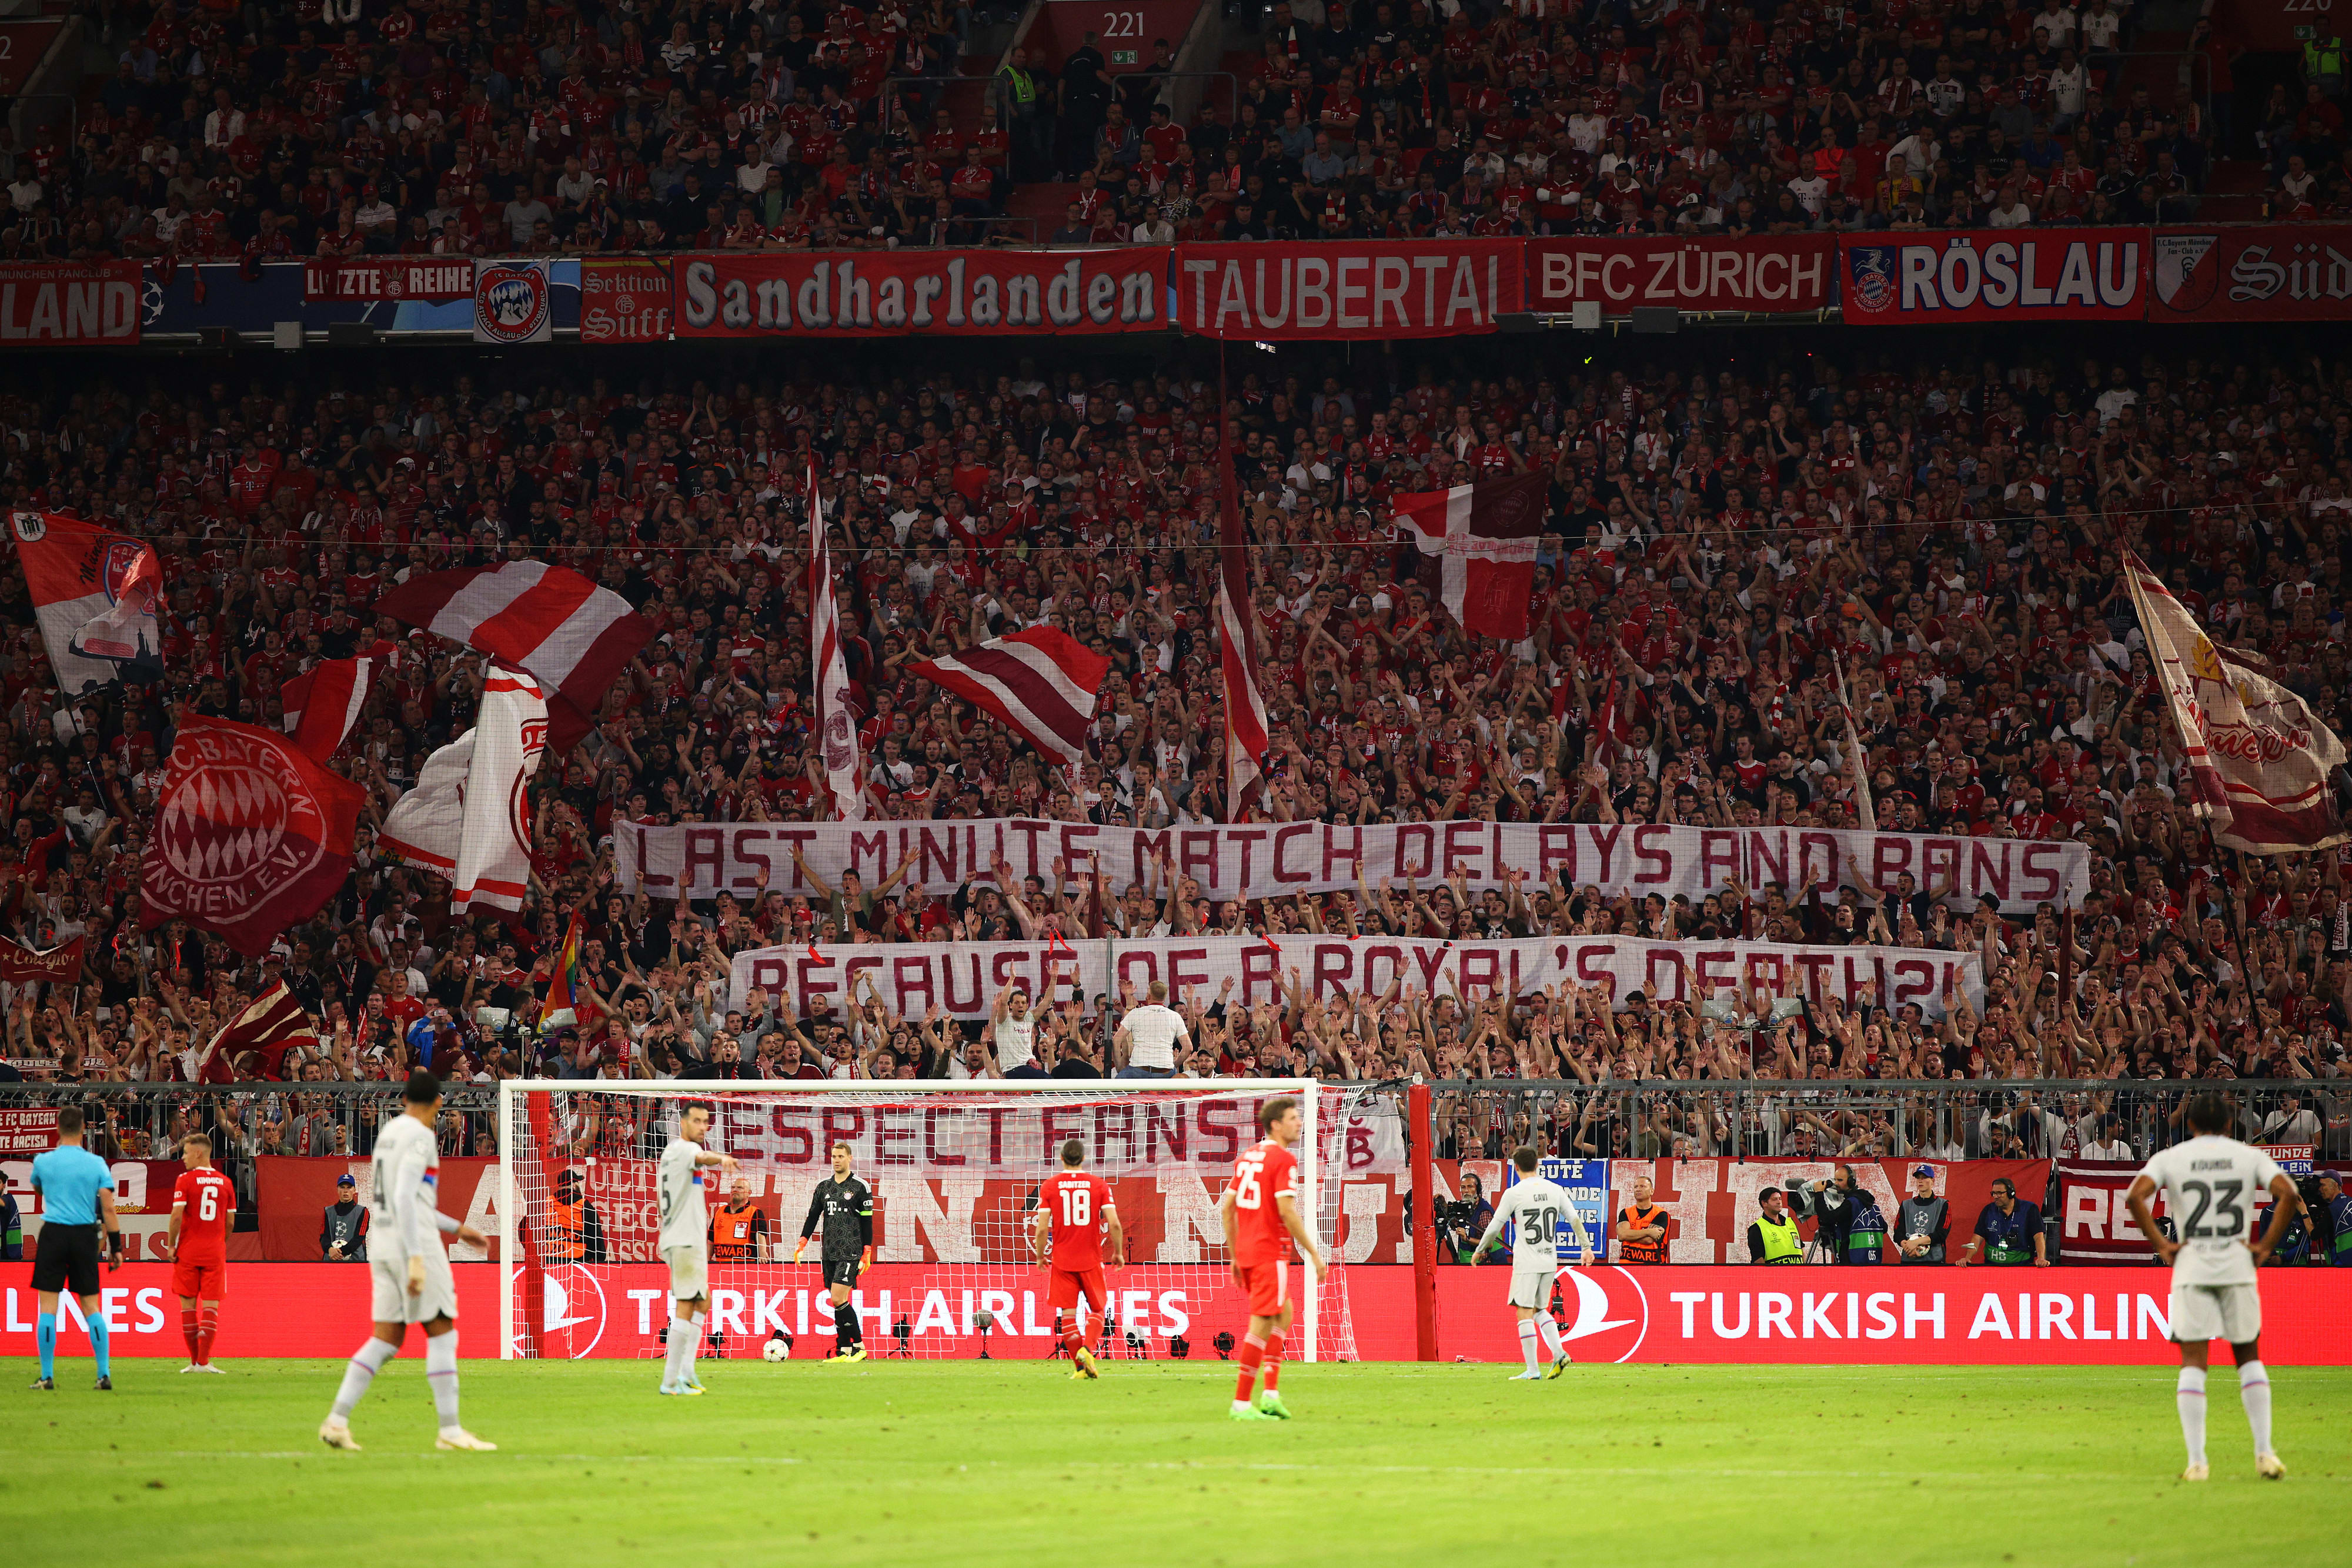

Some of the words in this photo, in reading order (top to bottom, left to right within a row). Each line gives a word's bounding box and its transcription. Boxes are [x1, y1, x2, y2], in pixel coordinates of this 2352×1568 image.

[1103, 12, 1144, 38] 221
[58, 268, 111, 279] FANCLUB
[410, 266, 472, 293] REIHE
[583, 272, 668, 295] Sektion
[1542, 252, 1635, 301] BFC
[1645, 245, 1823, 300] ZÜRICH
[1865, 274, 1888, 287] BAYERN
[1900, 237, 2139, 310] RÖSLAU
[684, 256, 1157, 329] Sandharlanden
[478, 305, 494, 330] ATTACK
[582, 307, 669, 340] Suff
[195, 735, 316, 816] BAYERN
[636, 828, 817, 888] LAST
[850, 821, 1098, 886] MINUTE
[1132, 825, 1362, 888] MATCH
[1394, 822, 1672, 884] DELAYS
[1702, 830, 1838, 893] AND
[1874, 837, 2062, 900] BANS
[752, 950, 1077, 1019] BECAUSE
[1118, 948, 1208, 1007] OF
[1240, 945, 1281, 1007] A
[6, 1113, 17, 1126] FC
[19, 1112, 56, 1126] BAYERN
[12, 1135, 48, 1149] RACISM
[196, 1176, 224, 1186] KIMMICH
[1058, 1181, 1091, 1189] SABITZER
[1236, 1161, 1264, 1210] 25
[1536, 1164, 1583, 1179] GUTE
[199, 1185, 219, 1221] 6
[1059, 1189, 1091, 1226] 18
[1533, 1193, 1548, 1202] GAVI
[2182, 1180, 2244, 1239] 23
[1522, 1206, 1558, 1245] 30
[1669, 1292, 1946, 1340] TURKISH
[1967, 1293, 2174, 1340] AIRLIN
